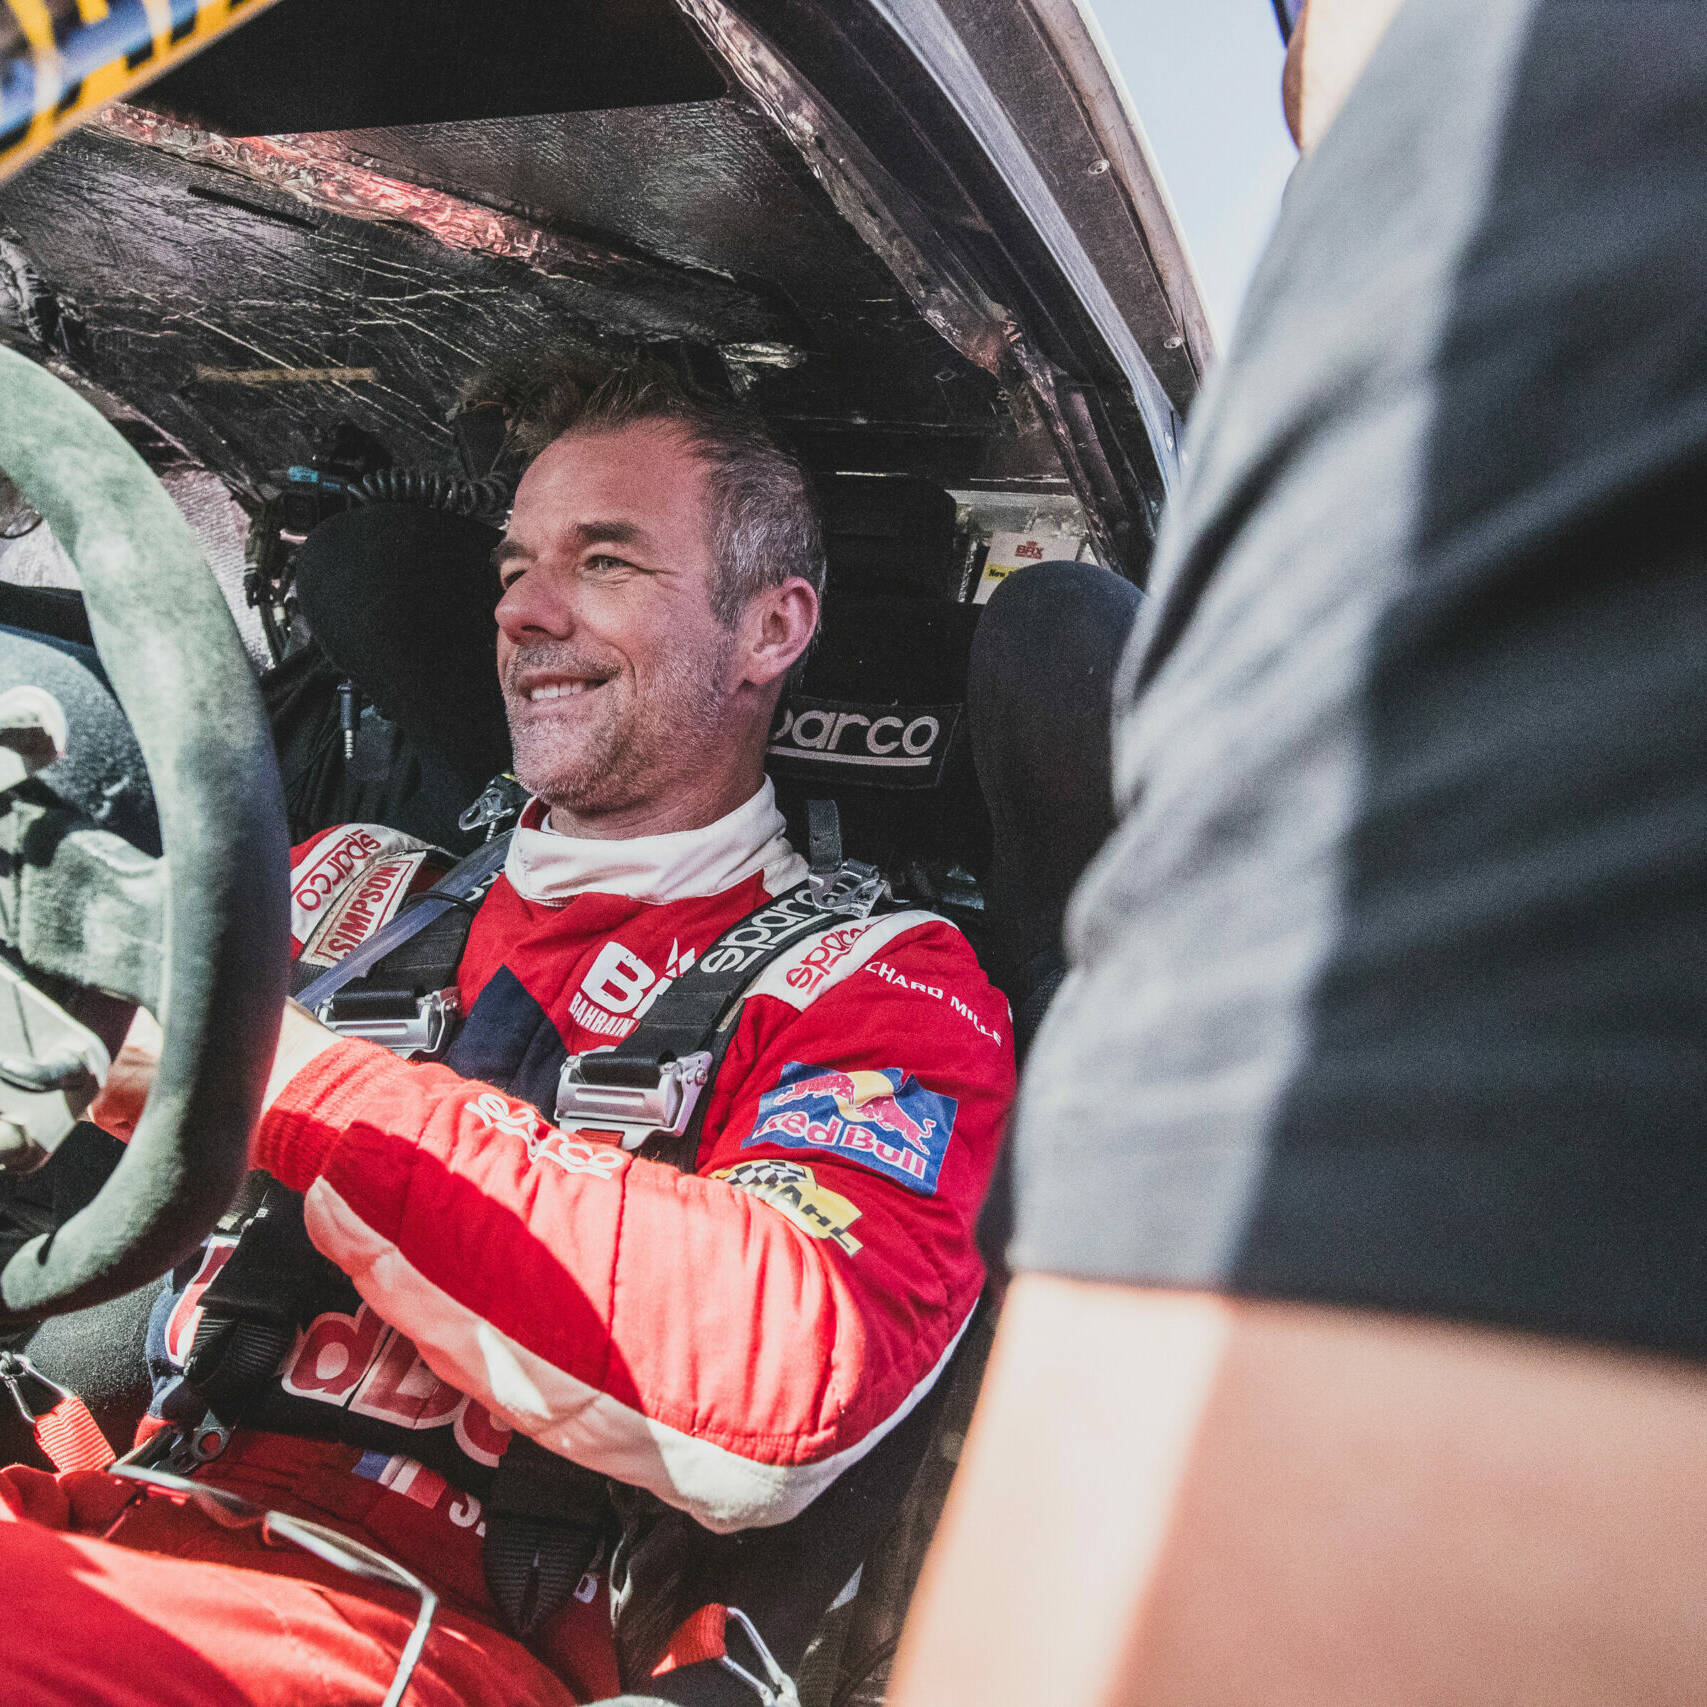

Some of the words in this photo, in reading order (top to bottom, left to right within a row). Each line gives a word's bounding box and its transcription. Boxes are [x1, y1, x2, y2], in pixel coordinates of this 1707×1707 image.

[773, 708, 940, 756] arco
[296, 833, 382, 912] sparco
[328, 866, 401, 956] SIMPSON
[700, 889, 815, 974] sparc
[568, 991, 636, 1038] BAHRAIN
[865, 961, 944, 1000] CHARD
[751, 1111, 844, 1146] Red
[838, 1124, 928, 1180] Bull
